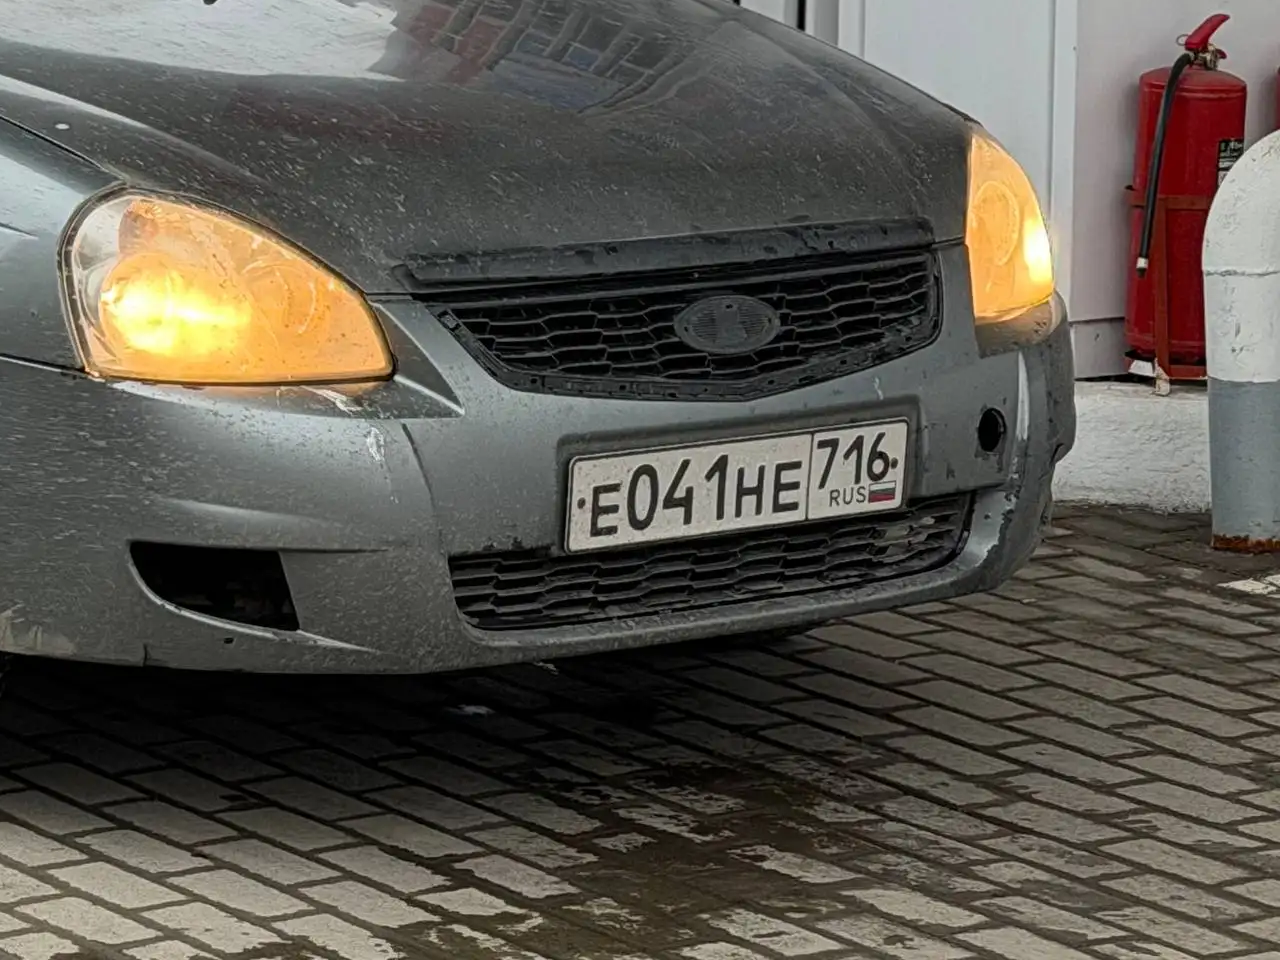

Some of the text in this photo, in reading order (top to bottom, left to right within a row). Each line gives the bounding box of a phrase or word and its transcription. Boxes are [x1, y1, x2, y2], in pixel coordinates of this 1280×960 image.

[589, 431, 891, 538] Е041НЕ 716
[829, 486, 868, 508] RUS
